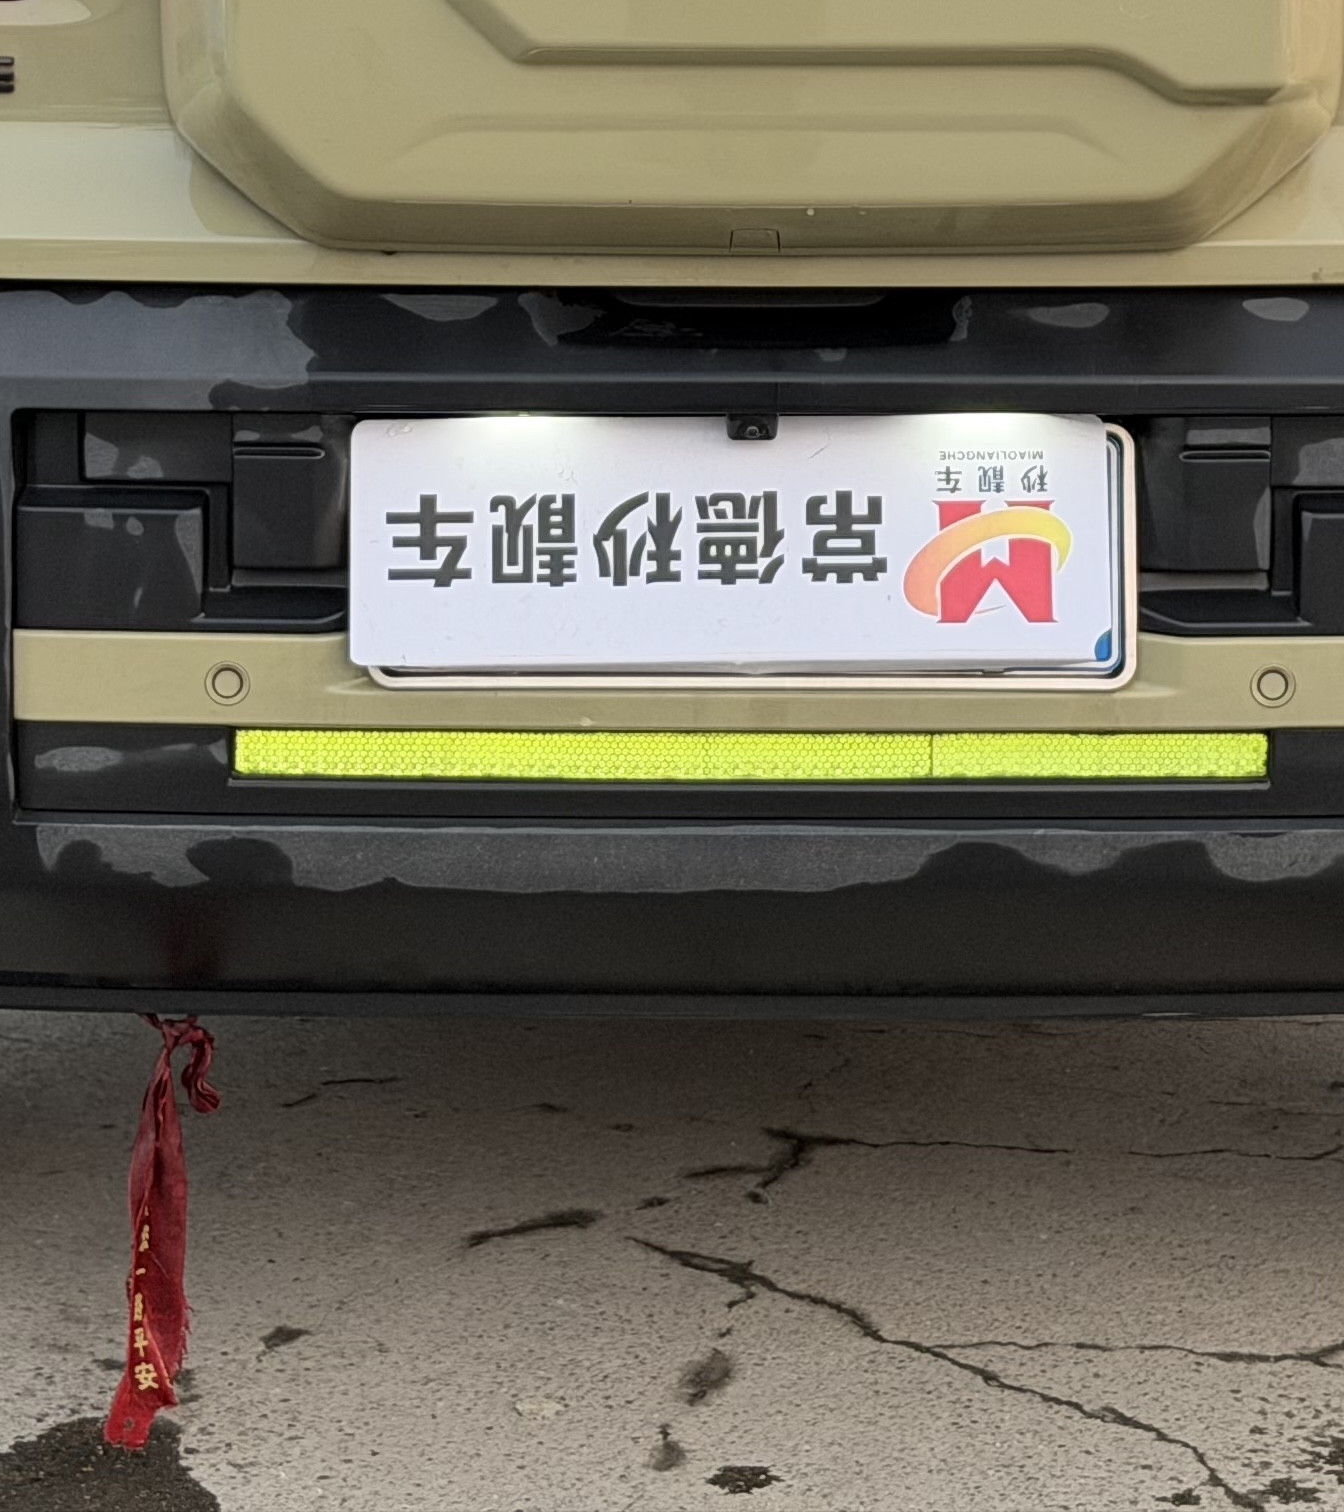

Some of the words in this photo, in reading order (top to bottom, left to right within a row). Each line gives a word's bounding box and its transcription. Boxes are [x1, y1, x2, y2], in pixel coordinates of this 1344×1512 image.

[939, 450, 1044, 461] MIAOLIANGCHE
[935, 465, 1048, 493] 秒靓车
[385, 490, 888, 587] 常德秒靓车
